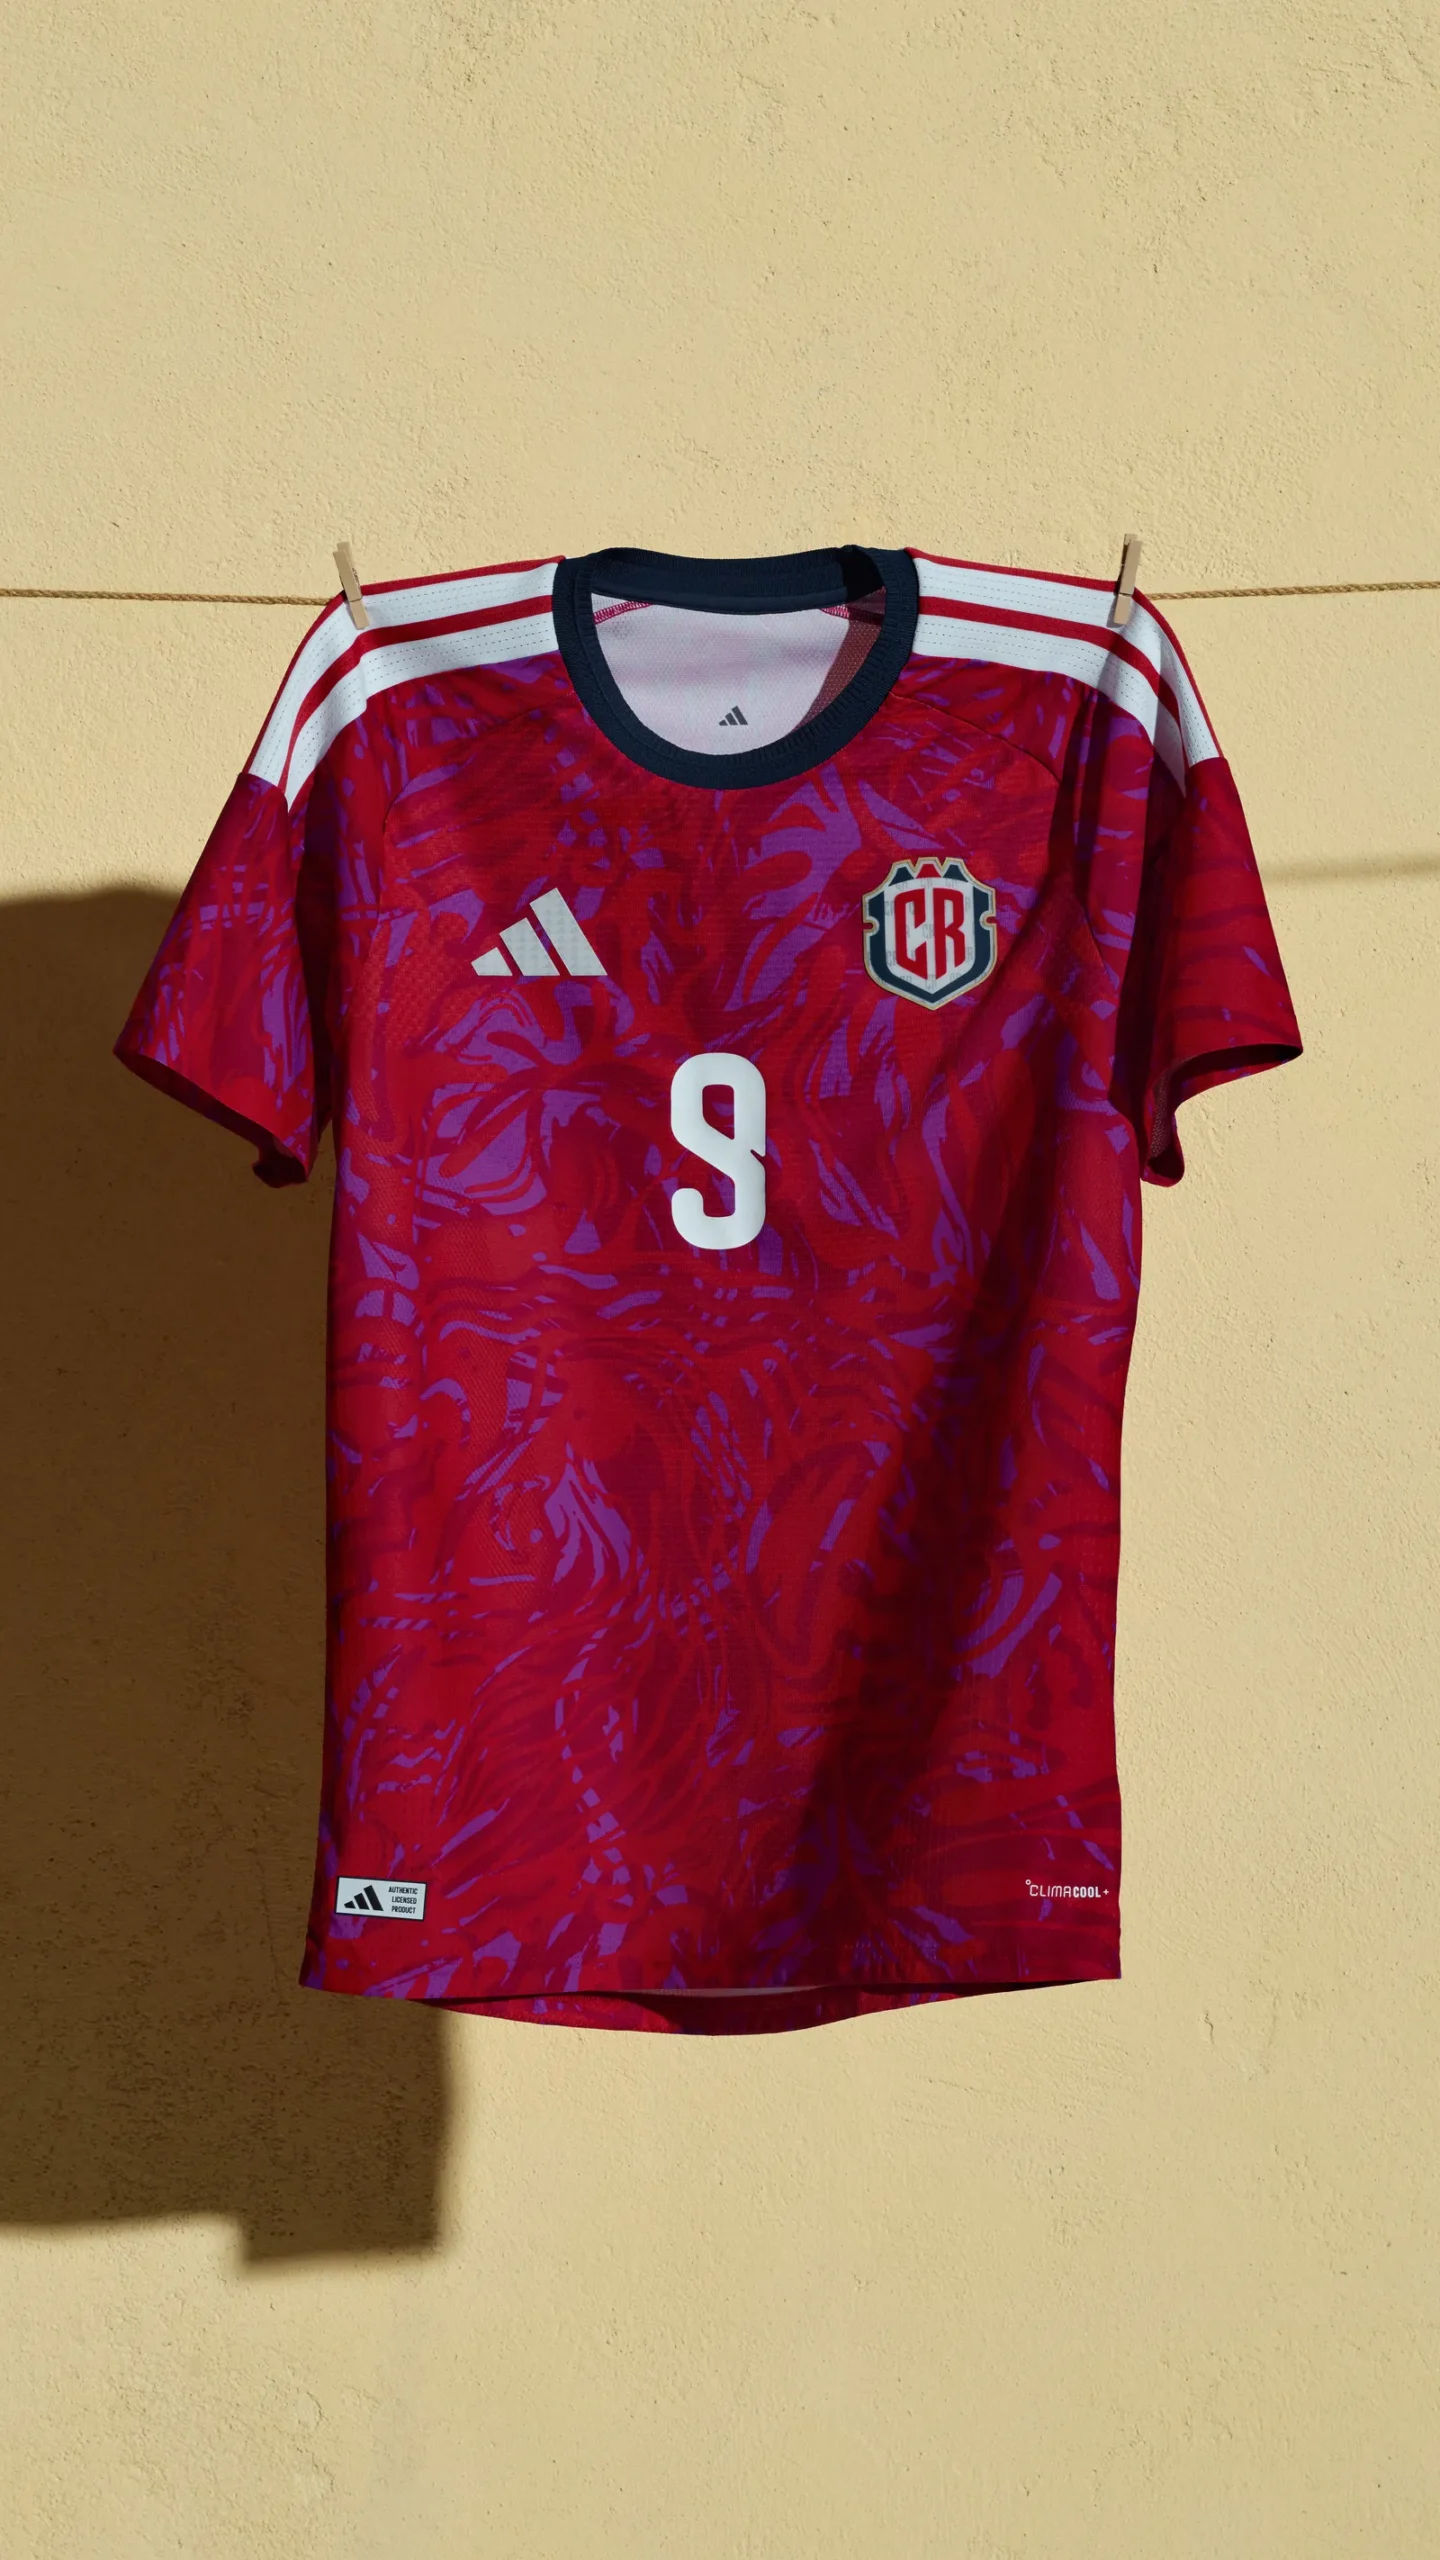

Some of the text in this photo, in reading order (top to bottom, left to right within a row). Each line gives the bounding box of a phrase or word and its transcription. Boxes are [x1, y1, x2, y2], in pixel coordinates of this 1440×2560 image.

[893, 887, 966, 981] CR
[670, 1052, 766, 1250] 9
[388, 1886, 418, 1895] AUTHENTIC
[391, 1896, 417, 1905] LICENSED
[391, 1905, 416, 1914] PRODUCT
